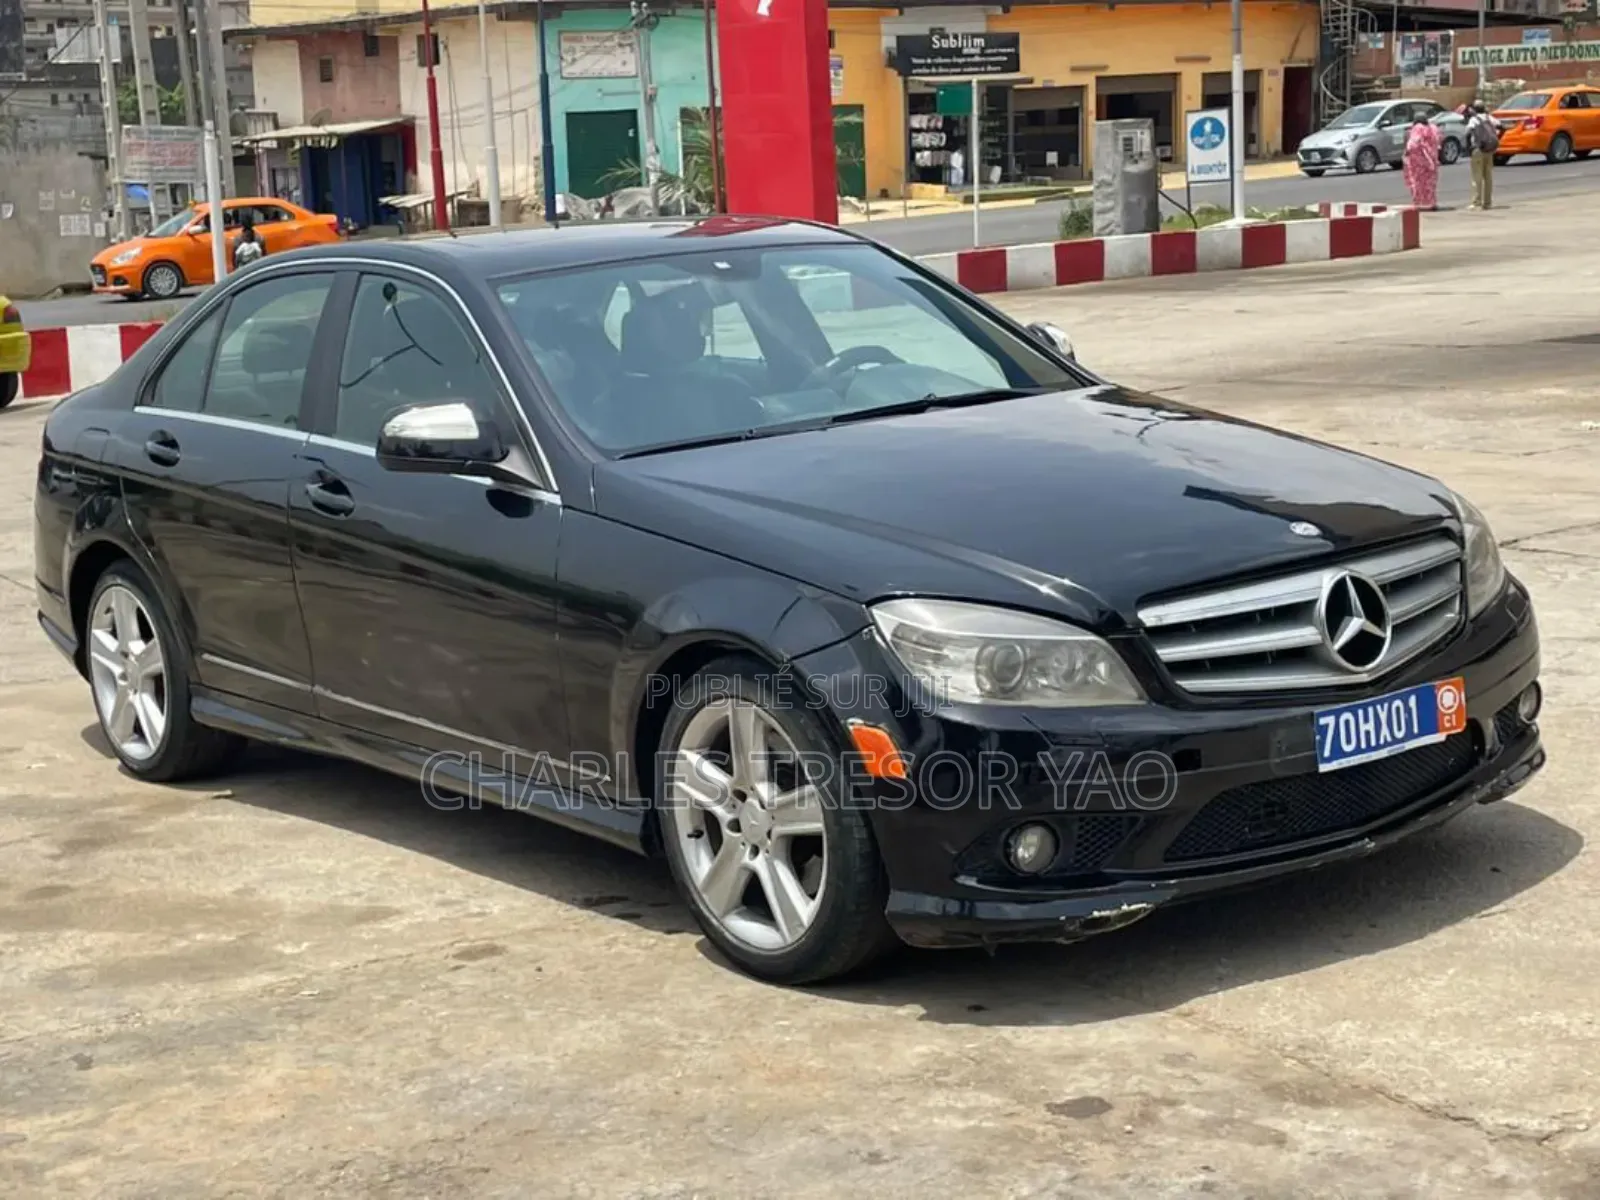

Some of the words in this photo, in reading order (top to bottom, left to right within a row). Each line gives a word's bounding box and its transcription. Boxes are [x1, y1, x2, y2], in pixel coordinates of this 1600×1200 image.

[1507, 46, 1537, 63] AUTO
[1318, 694, 1418, 758] 70HX01
[1443, 714, 1457, 727] CI
